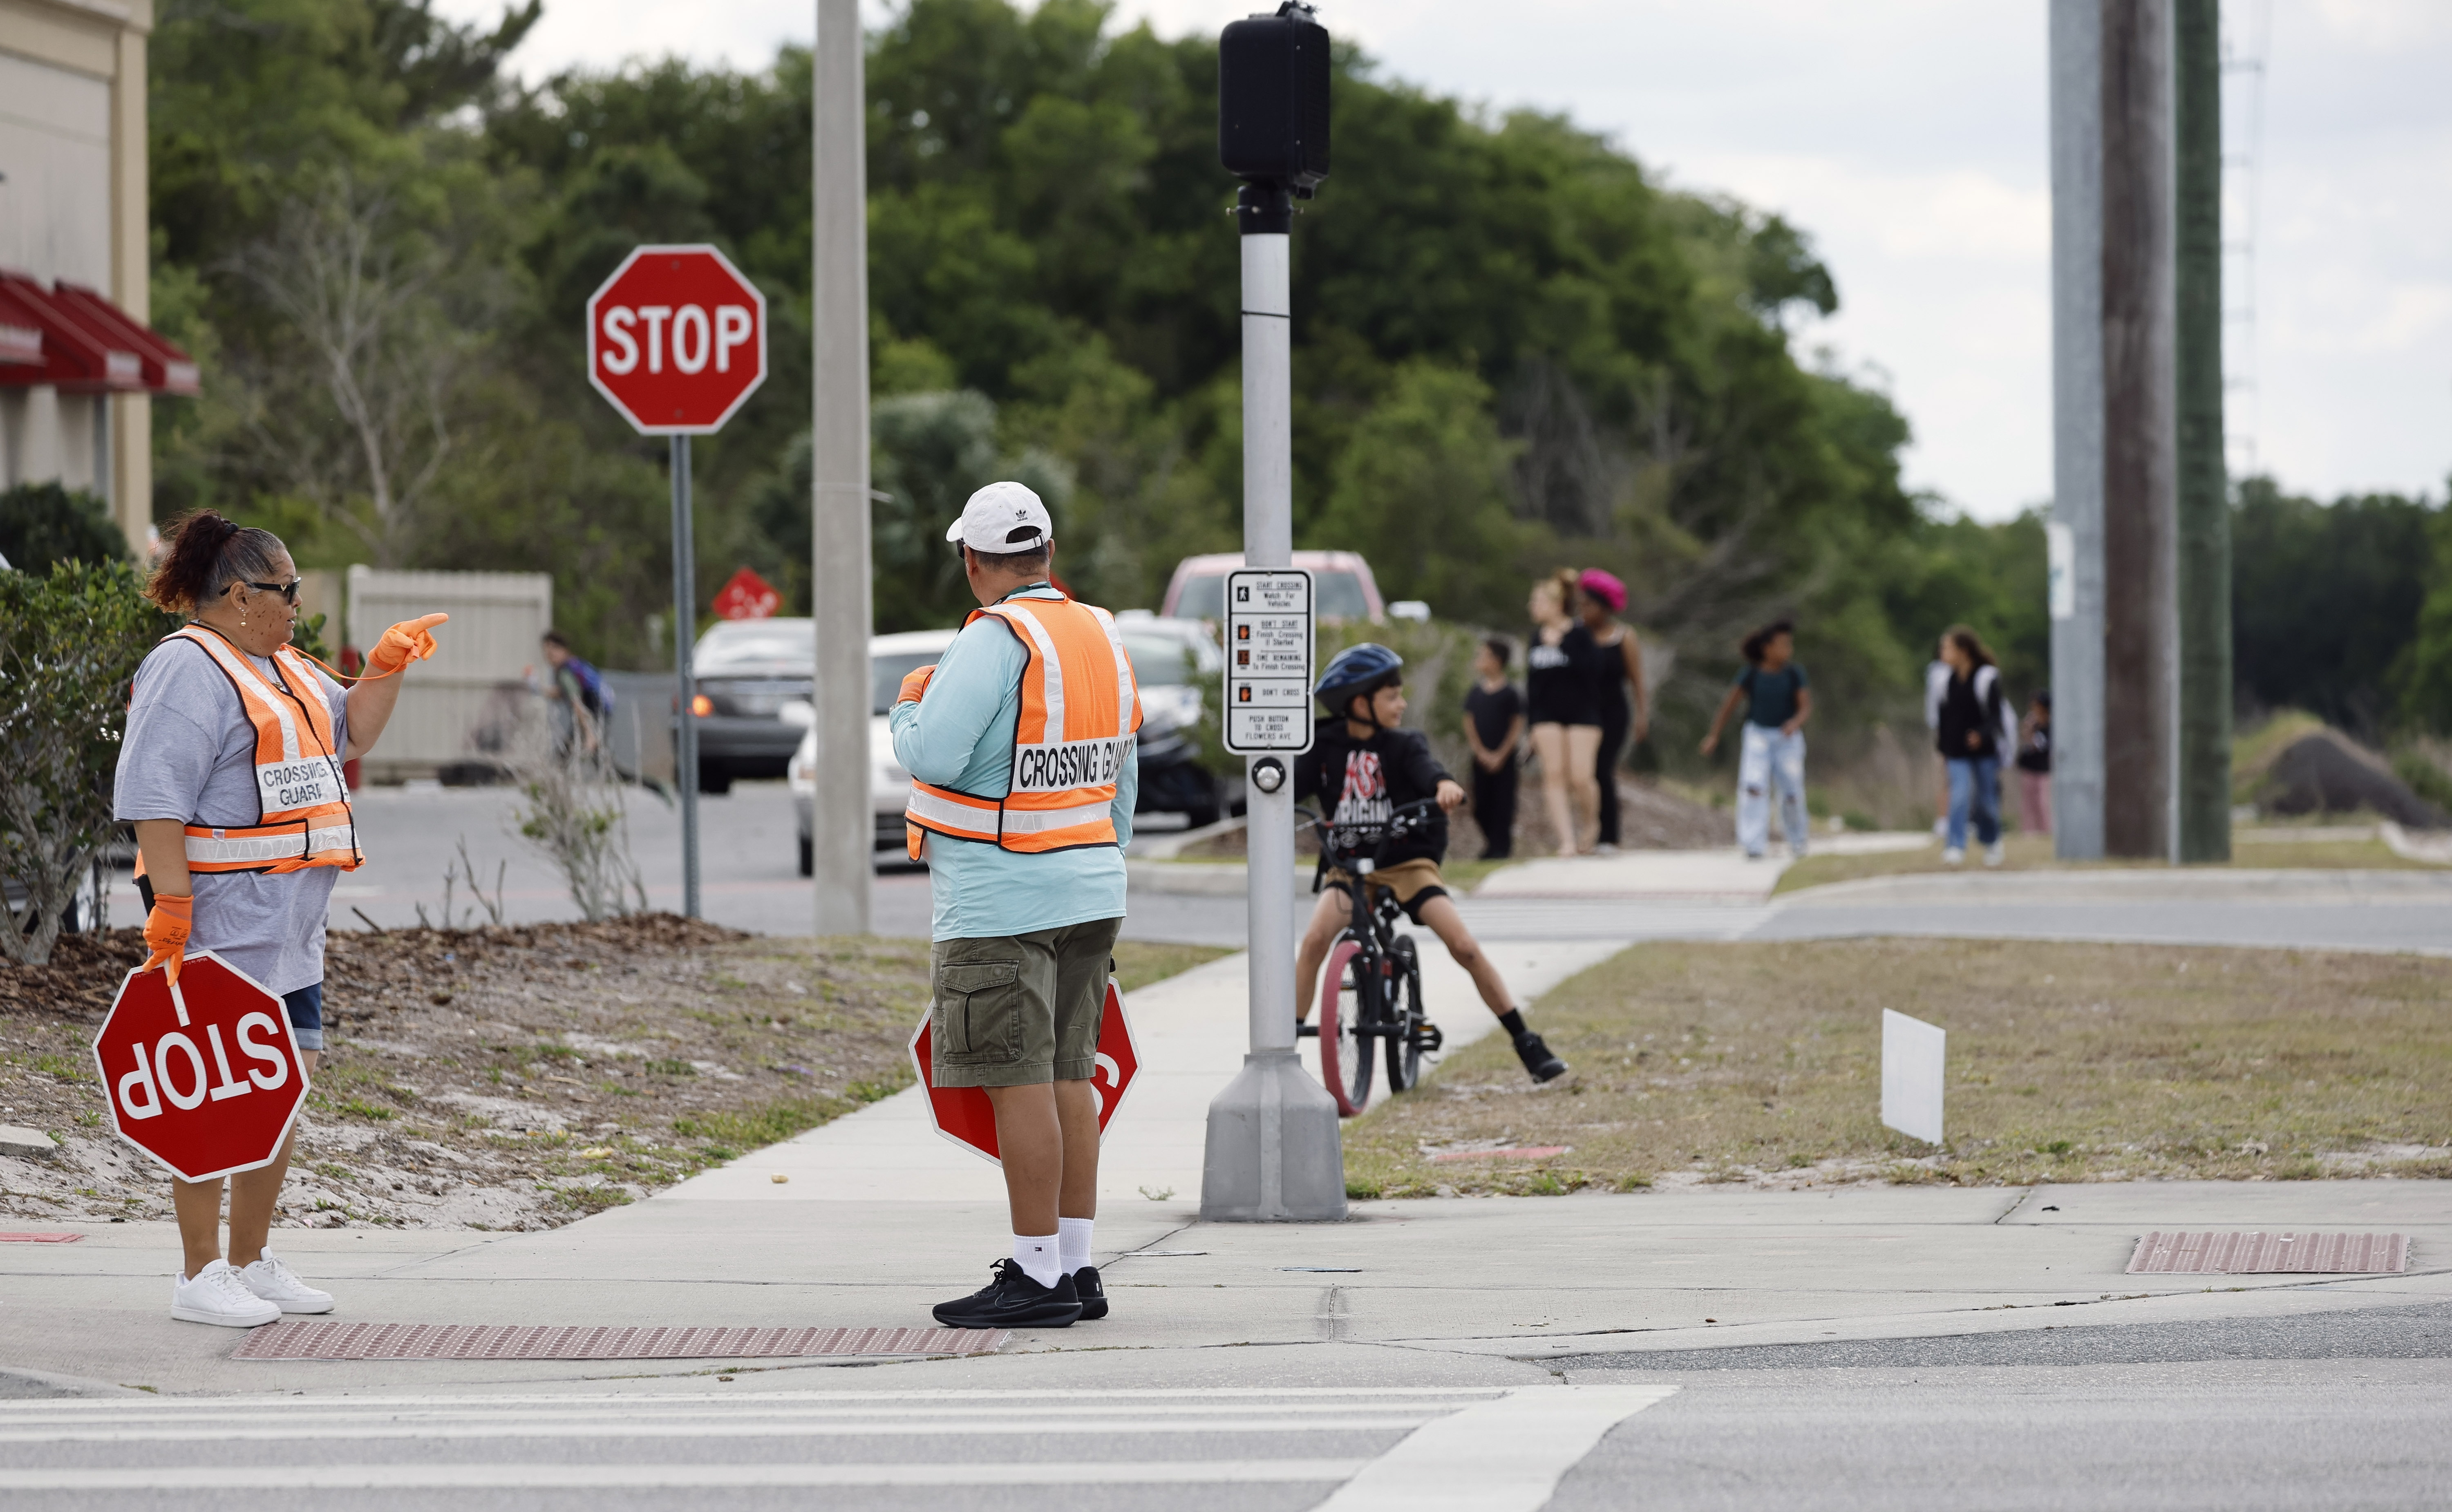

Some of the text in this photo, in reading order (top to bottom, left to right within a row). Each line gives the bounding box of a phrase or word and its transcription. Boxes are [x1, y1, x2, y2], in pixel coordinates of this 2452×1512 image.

[602, 304, 753, 375] STOP
[1020, 743, 1098, 787] CROSSING
[118, 1011, 288, 1120] STOP
